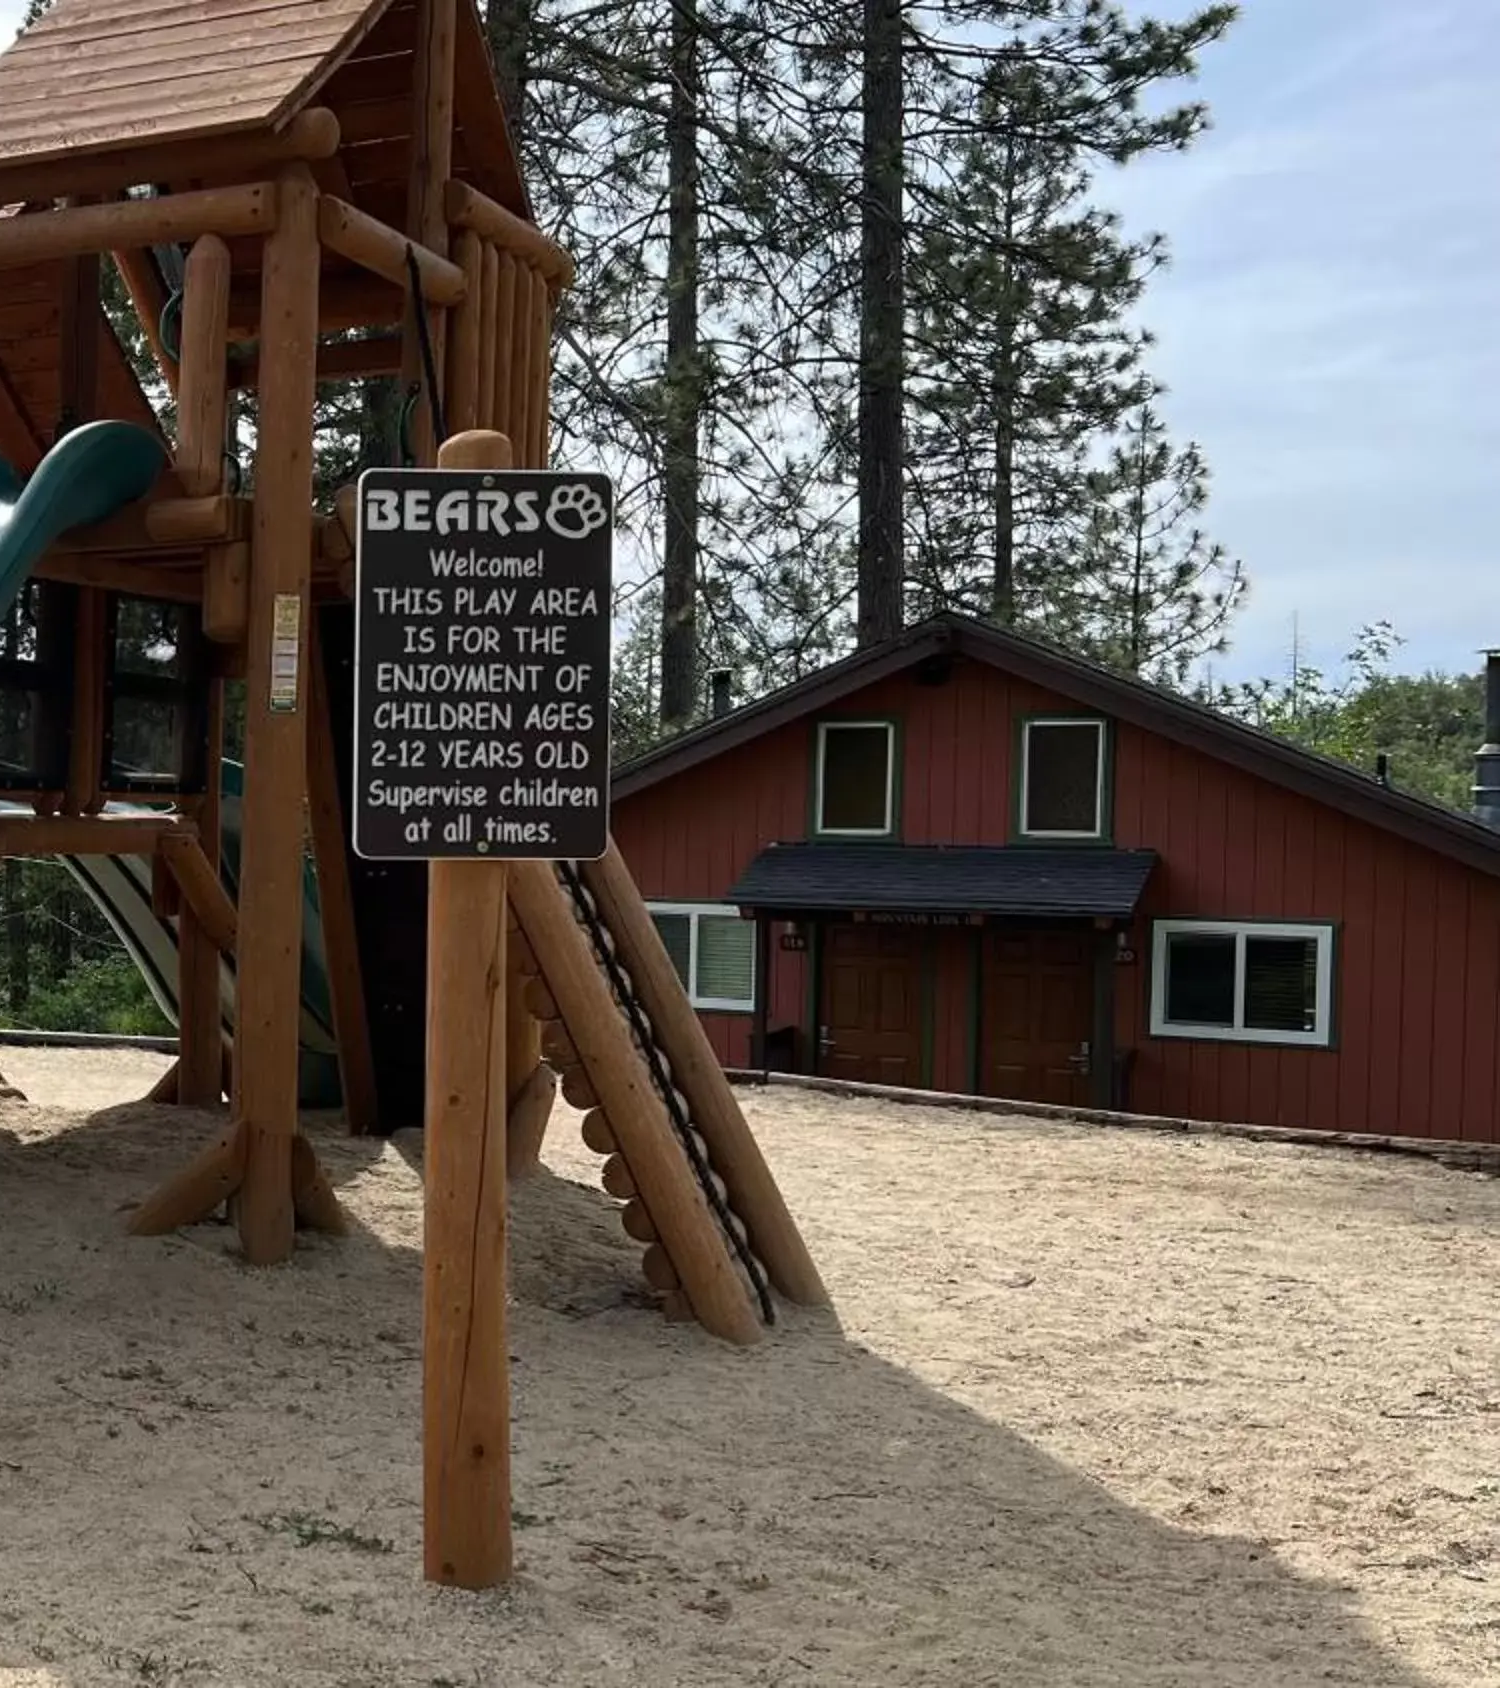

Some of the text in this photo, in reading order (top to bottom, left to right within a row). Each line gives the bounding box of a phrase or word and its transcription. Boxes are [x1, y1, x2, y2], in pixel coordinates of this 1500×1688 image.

[367, 490, 540, 536] BEARS
[430, 549, 543, 578] Welcome!
[374, 587, 597, 616] THIS PLAY AREA
[404, 626, 566, 654] IS FOR THE
[377, 663, 592, 693] ENJOYMENT OF
[374, 702, 593, 731] CHILDREN AGES
[372, 740, 588, 769] 2-12 YEARS OLD
[368, 777, 597, 814] Supervise children
[405, 813, 557, 844] at all times.
